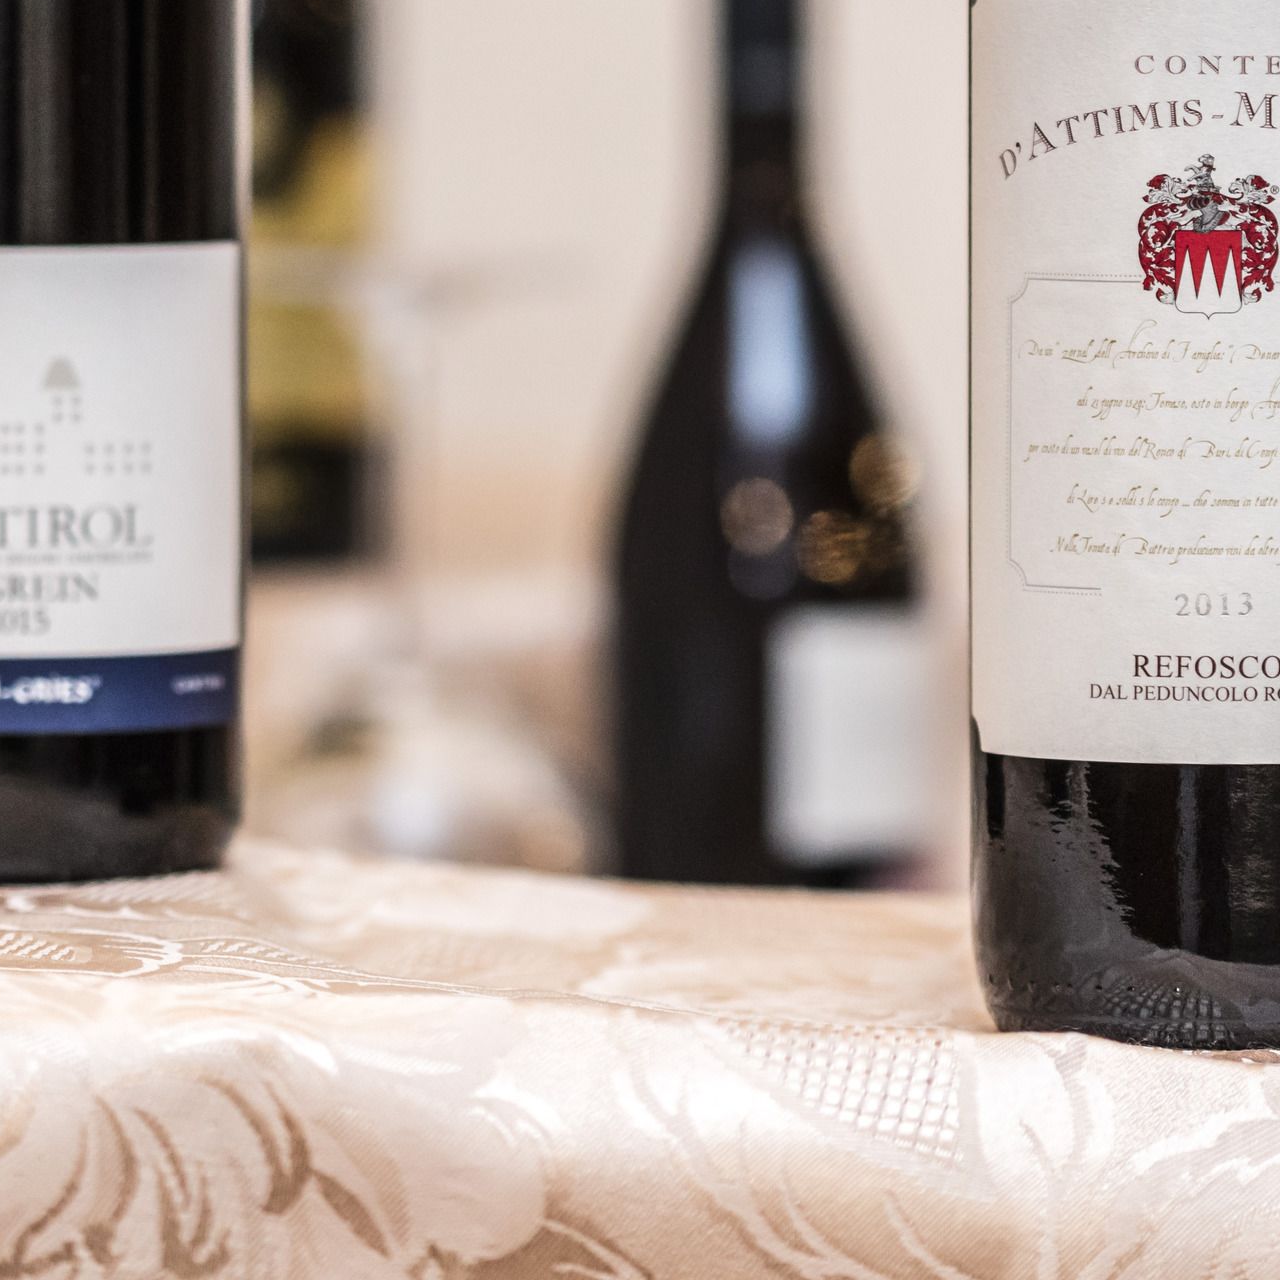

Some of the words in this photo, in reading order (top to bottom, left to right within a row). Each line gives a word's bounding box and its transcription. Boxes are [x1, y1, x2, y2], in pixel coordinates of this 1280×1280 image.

[1175, 592, 1254, 618] 2013
[1089, 683, 1128, 701] DAL
[1132, 683, 1259, 702] PEDUNCOLO
